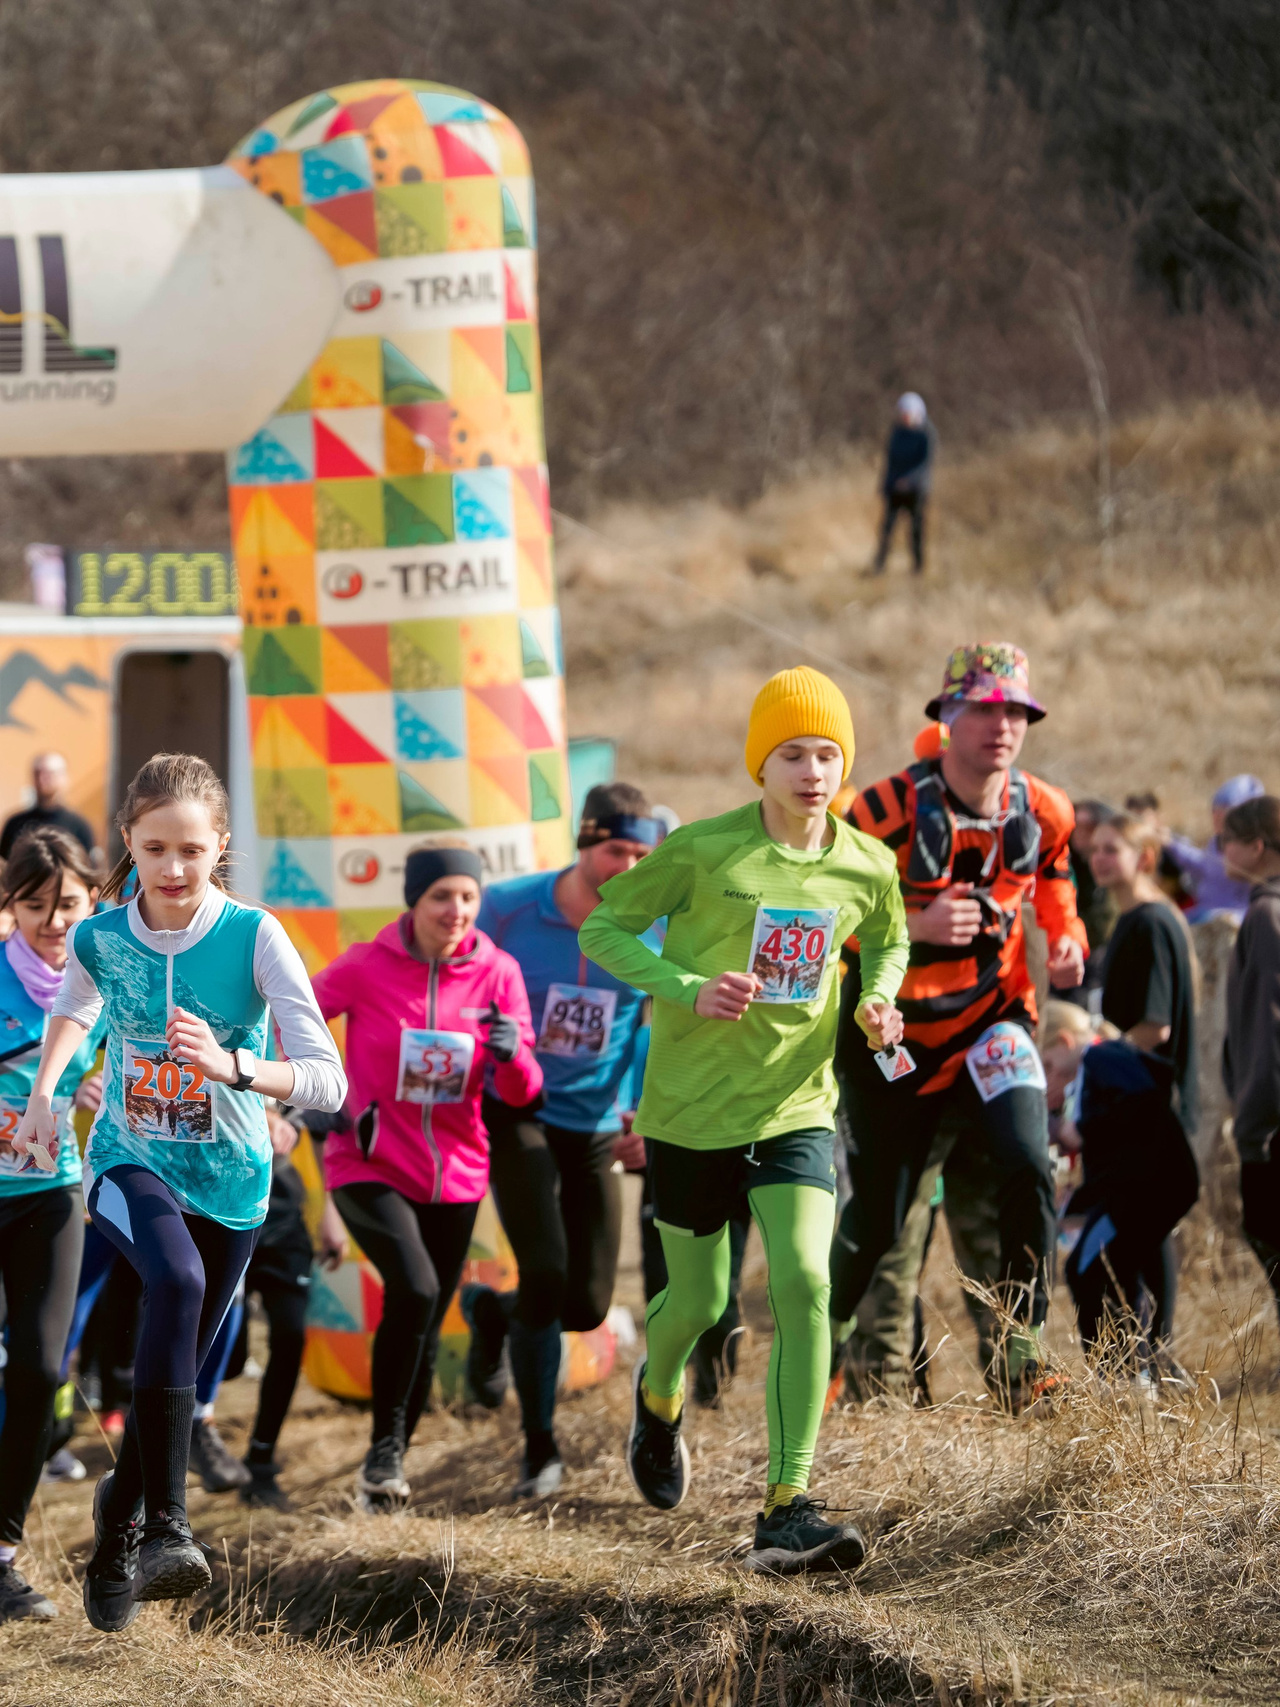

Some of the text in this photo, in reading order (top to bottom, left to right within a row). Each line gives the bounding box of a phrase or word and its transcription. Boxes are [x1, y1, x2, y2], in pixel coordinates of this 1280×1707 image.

[760, 927, 826, 962] 430
[553, 1000, 605, 1031] 948
[421, 1049, 453, 1077] 53
[986, 1035, 1017, 1061] 67
[131, 1058, 207, 1102] 202
